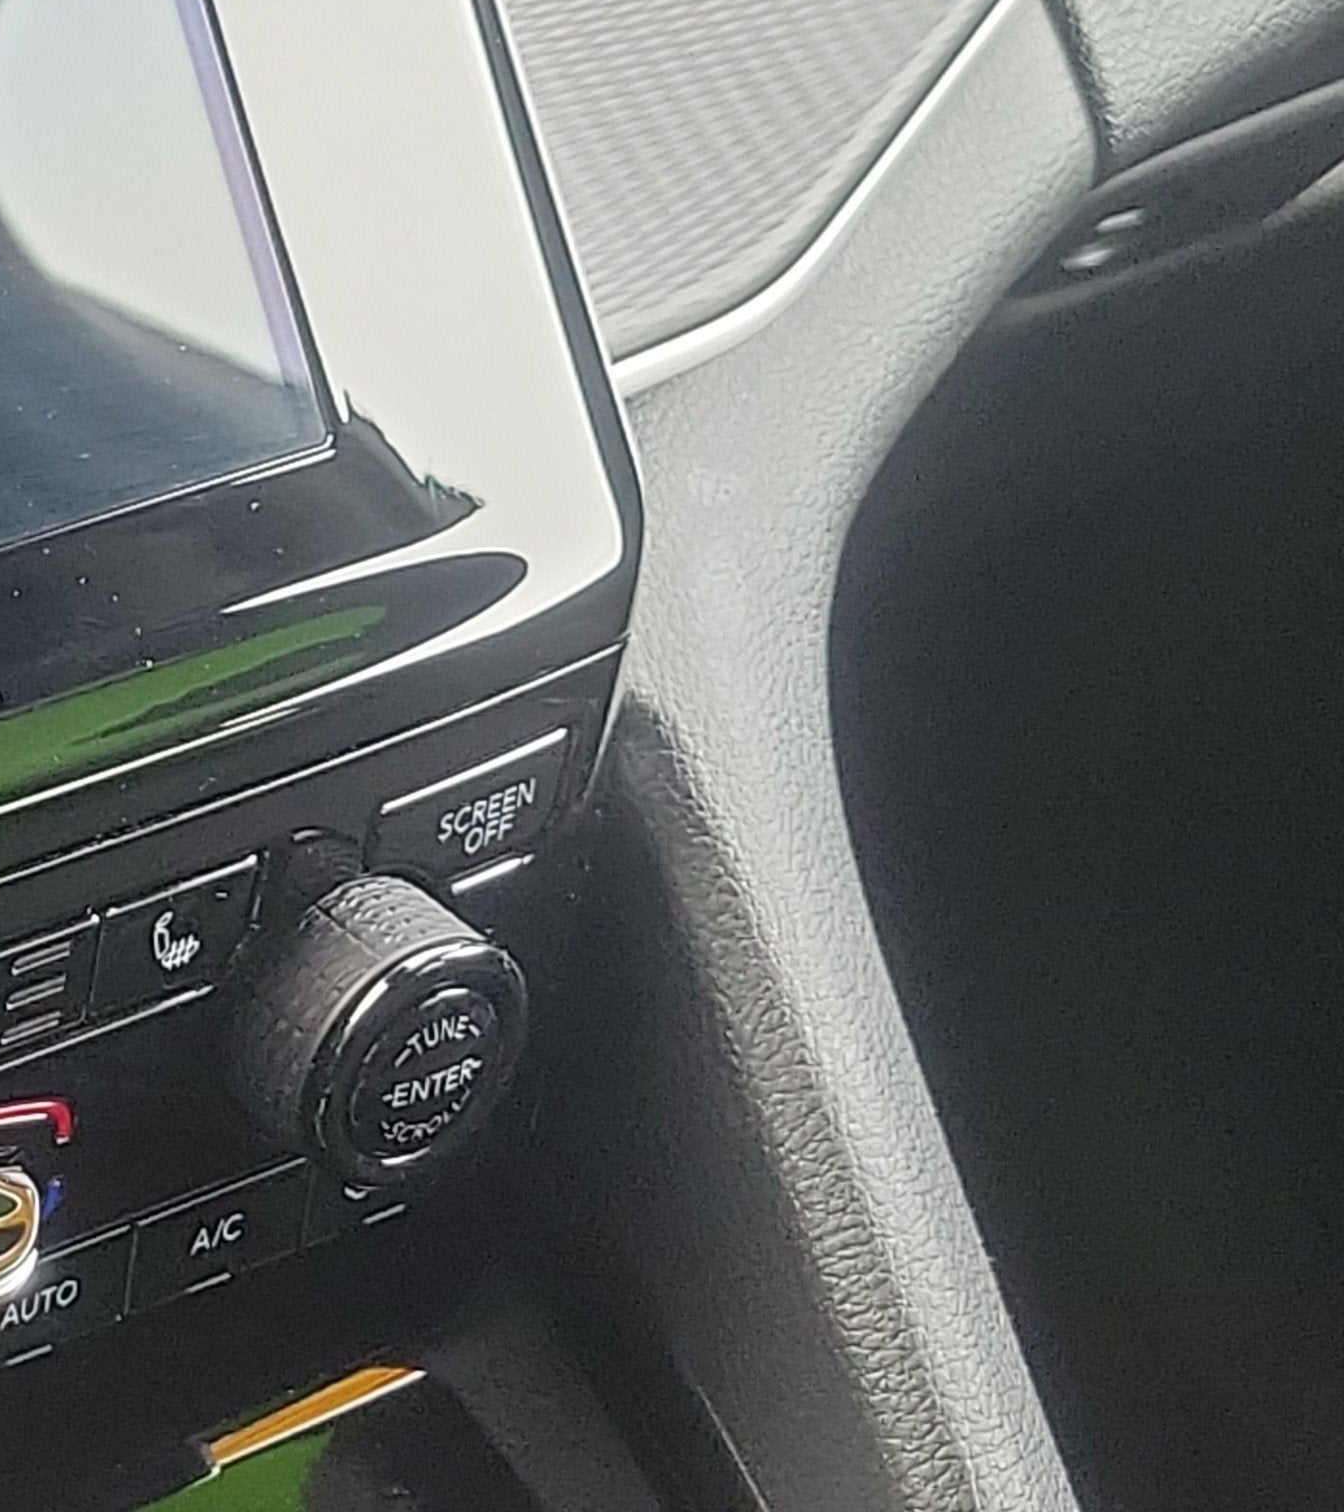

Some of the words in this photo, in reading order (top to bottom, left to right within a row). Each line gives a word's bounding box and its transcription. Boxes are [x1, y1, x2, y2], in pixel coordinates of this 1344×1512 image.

[437, 777, 536, 842] SCREEN
[464, 813, 515, 854] OFF
[406, 1014, 470, 1055] TUNE
[391, 1056, 474, 1108] ENTER
[189, 1212, 244, 1256] A/C
[0, 1279, 78, 1331] AUTO
